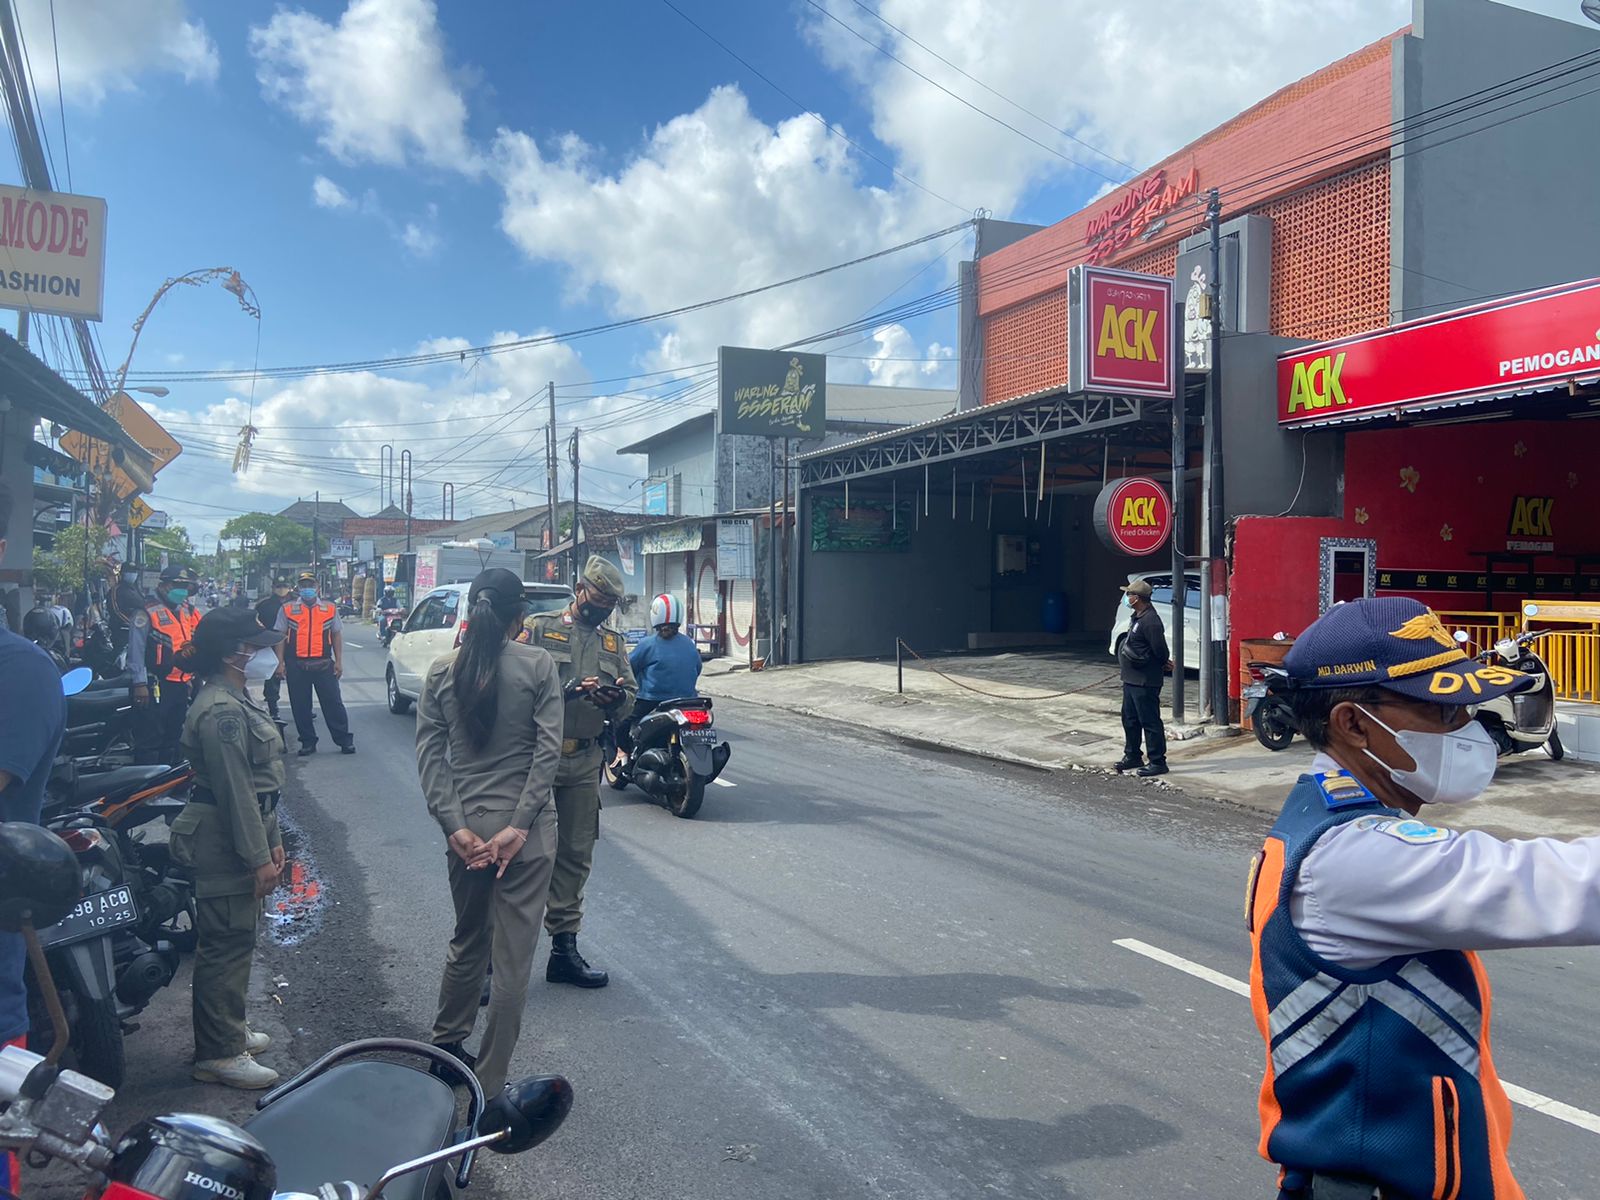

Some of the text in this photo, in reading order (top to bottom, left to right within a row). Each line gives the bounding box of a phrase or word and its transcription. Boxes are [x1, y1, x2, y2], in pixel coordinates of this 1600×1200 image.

[1084, 169, 1164, 245] WARUNG
[1097, 303, 1158, 362] ACK
[1499, 343, 1600, 377] PEMOGAN
[734, 384, 779, 402] WARUNG
[1288, 352, 1347, 413] ACK
[737, 391, 813, 419] SSSERAM
[1121, 497, 1156, 526] ACK
[1510, 497, 1553, 536] ACK
[1120, 529, 1160, 537] Fried Chicken
[1334, 659, 1377, 674] DARWIN
[184, 1171, 245, 1200] HONDA
